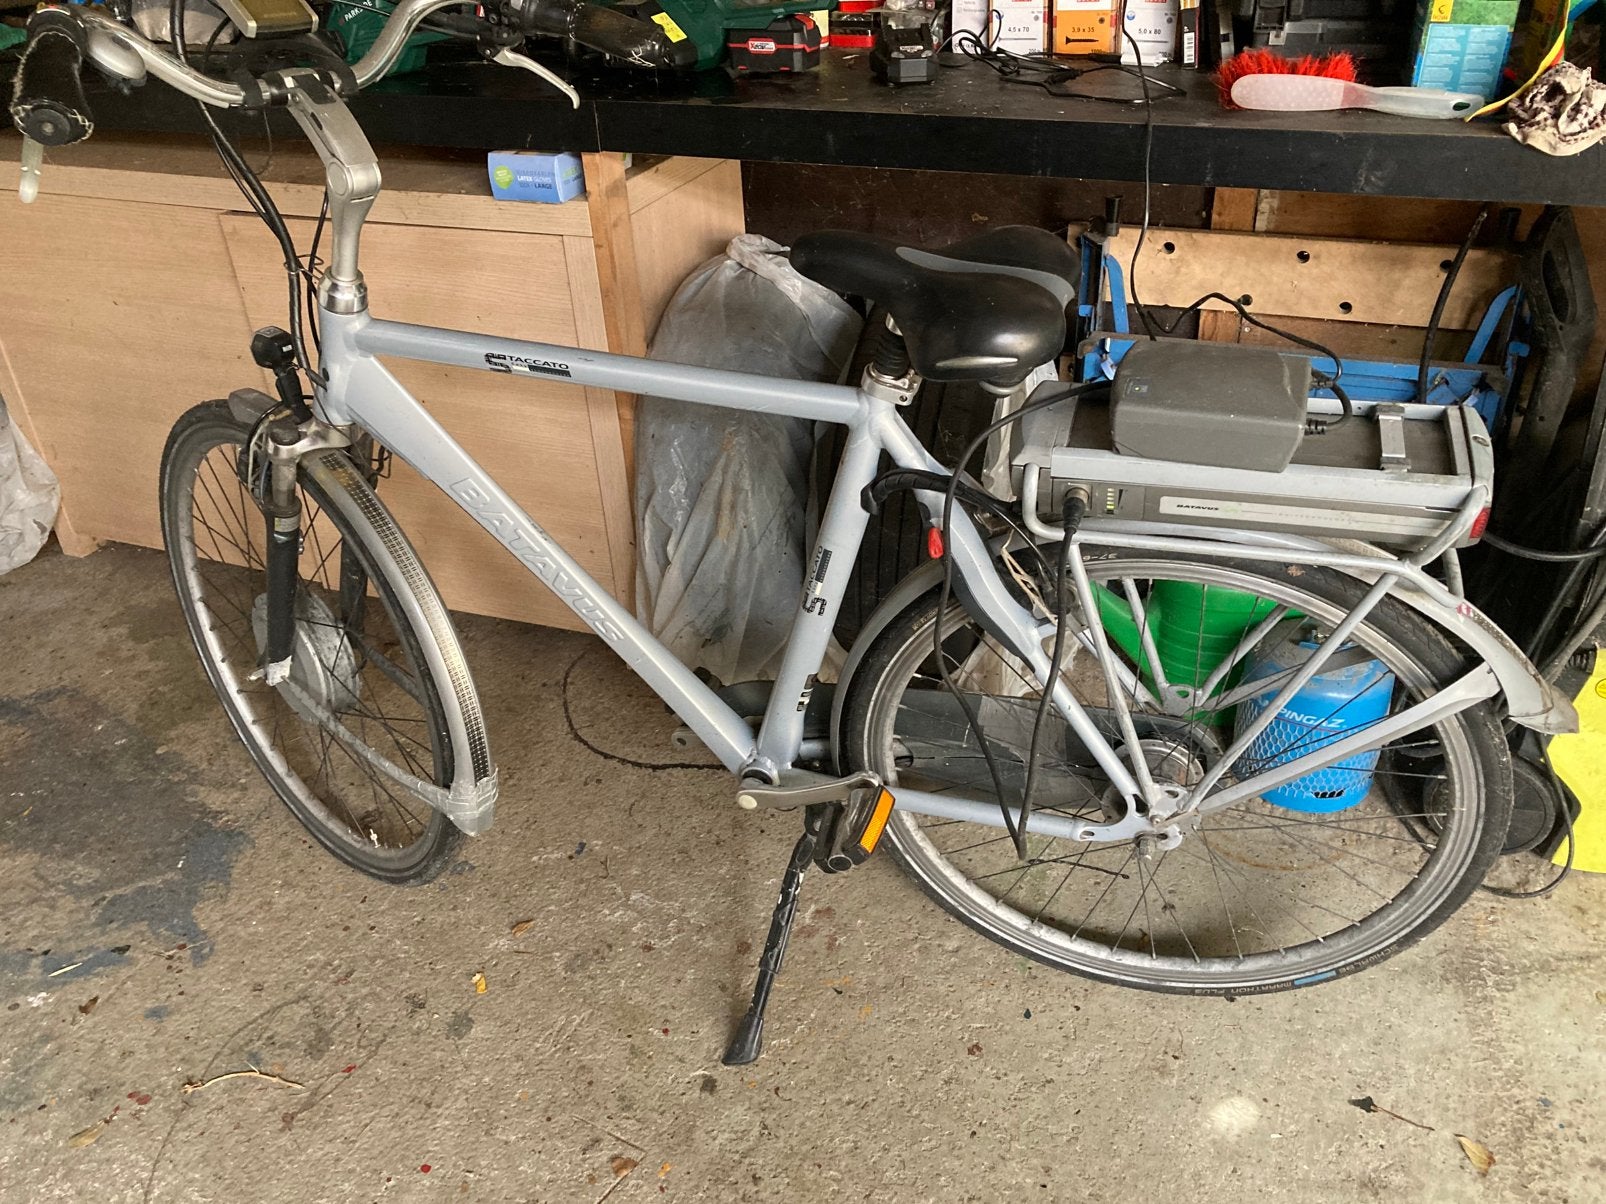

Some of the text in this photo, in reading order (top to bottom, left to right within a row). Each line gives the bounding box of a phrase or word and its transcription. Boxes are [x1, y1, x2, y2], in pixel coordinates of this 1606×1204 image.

[344, 0, 373, 21] PARKSDE
[1176, 503, 1220, 511] BATAVUS
[450, 478, 625, 643] BATAVUS
[1278, 708, 1346, 728] PINGAZ
[1194, 987, 1226, 996] PLUS
[1230, 981, 1292, 994] MARATHON
